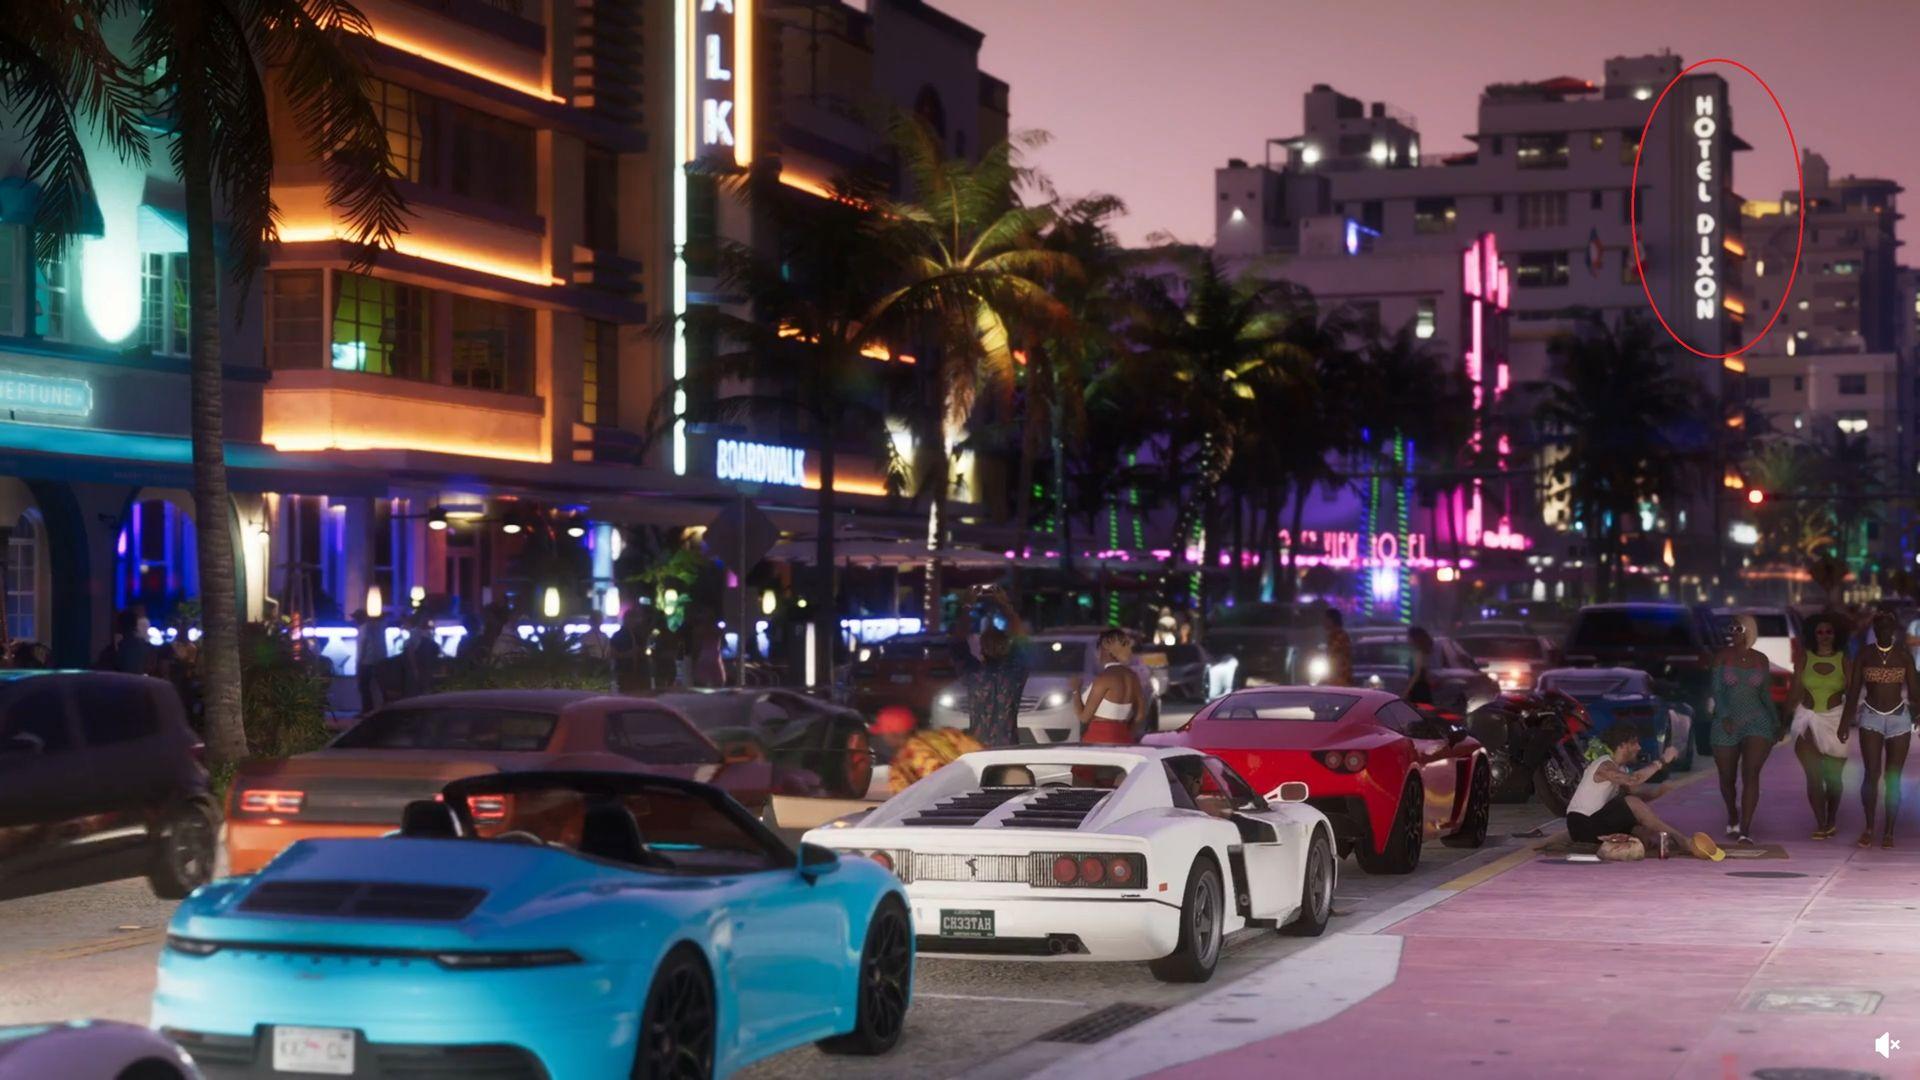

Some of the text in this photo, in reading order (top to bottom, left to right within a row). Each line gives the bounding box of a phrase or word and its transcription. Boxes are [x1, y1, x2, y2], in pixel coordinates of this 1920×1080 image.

[1694, 95, 1717, 319] HOTEL DIXON
[716, 439, 805, 487] BOARDWALK
[943, 916, 992, 930] CH33TAH
